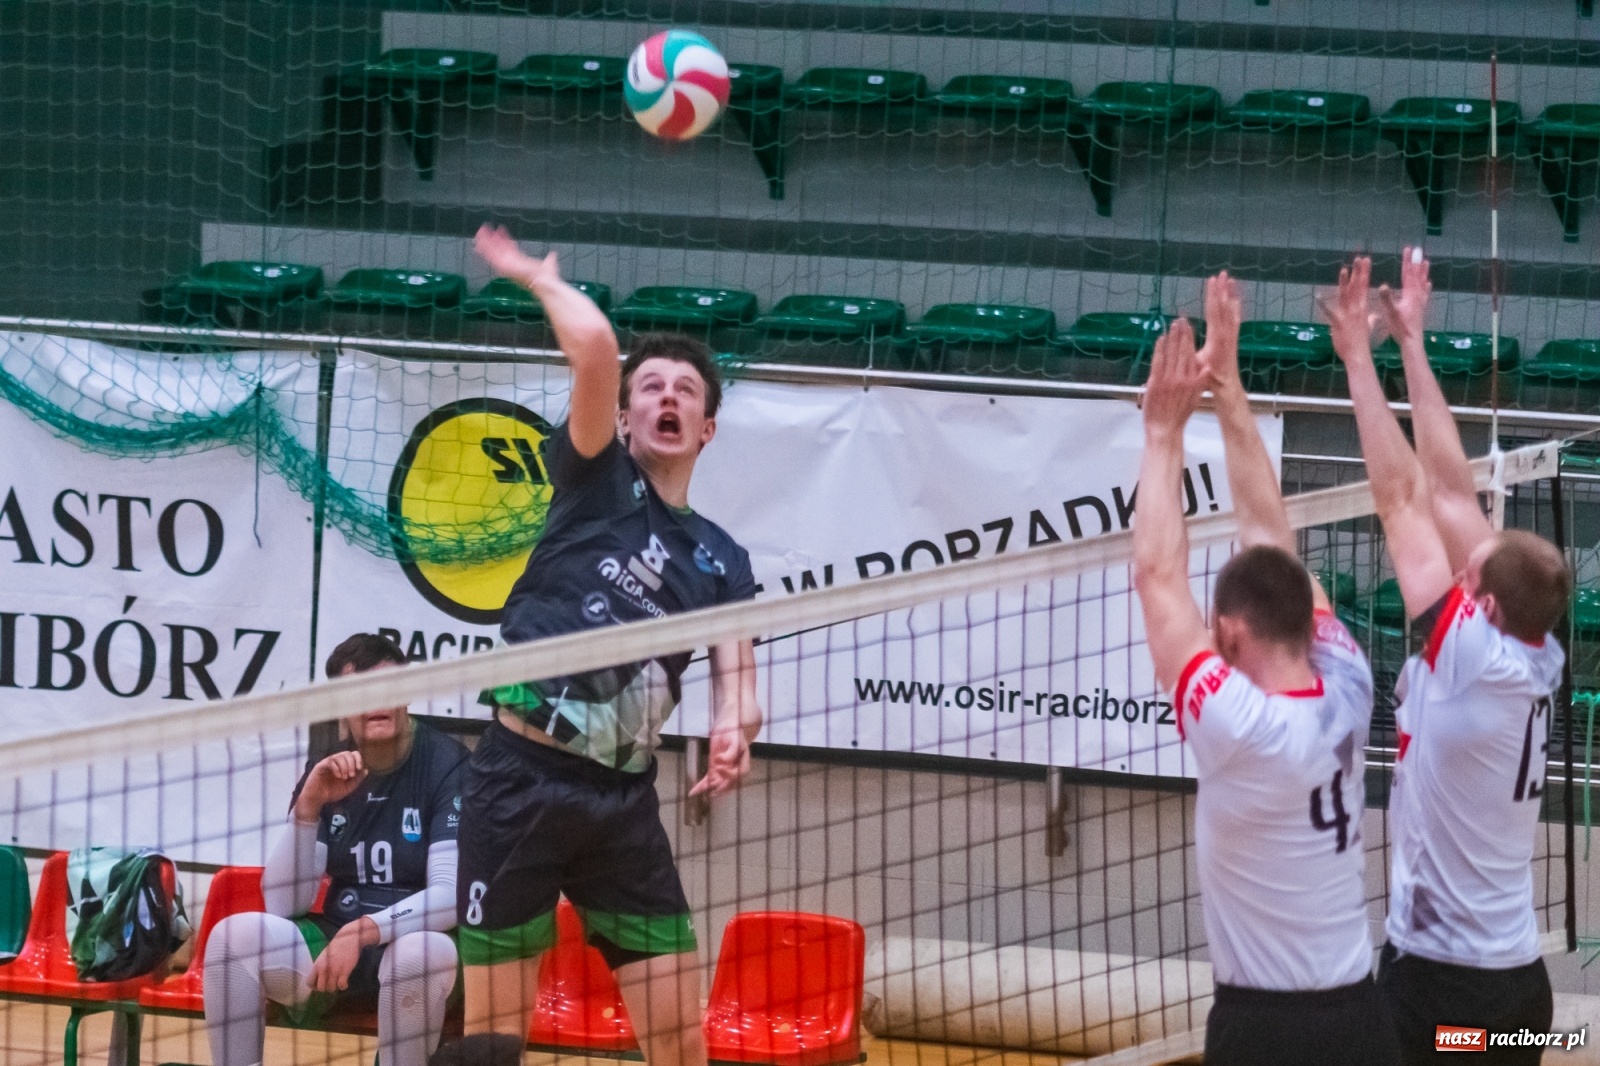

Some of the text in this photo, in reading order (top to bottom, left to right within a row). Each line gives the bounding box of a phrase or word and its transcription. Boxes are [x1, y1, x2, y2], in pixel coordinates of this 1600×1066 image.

[481, 437, 547, 485] SI
[0, 486, 224, 577] ASTO
[0, 595, 282, 700] IBÓRZ
[854, 678, 1176, 725] www.osir-raciborz
[1310, 770, 1350, 853] 4
[350, 841, 393, 884] 19
[466, 881, 487, 925] 8
